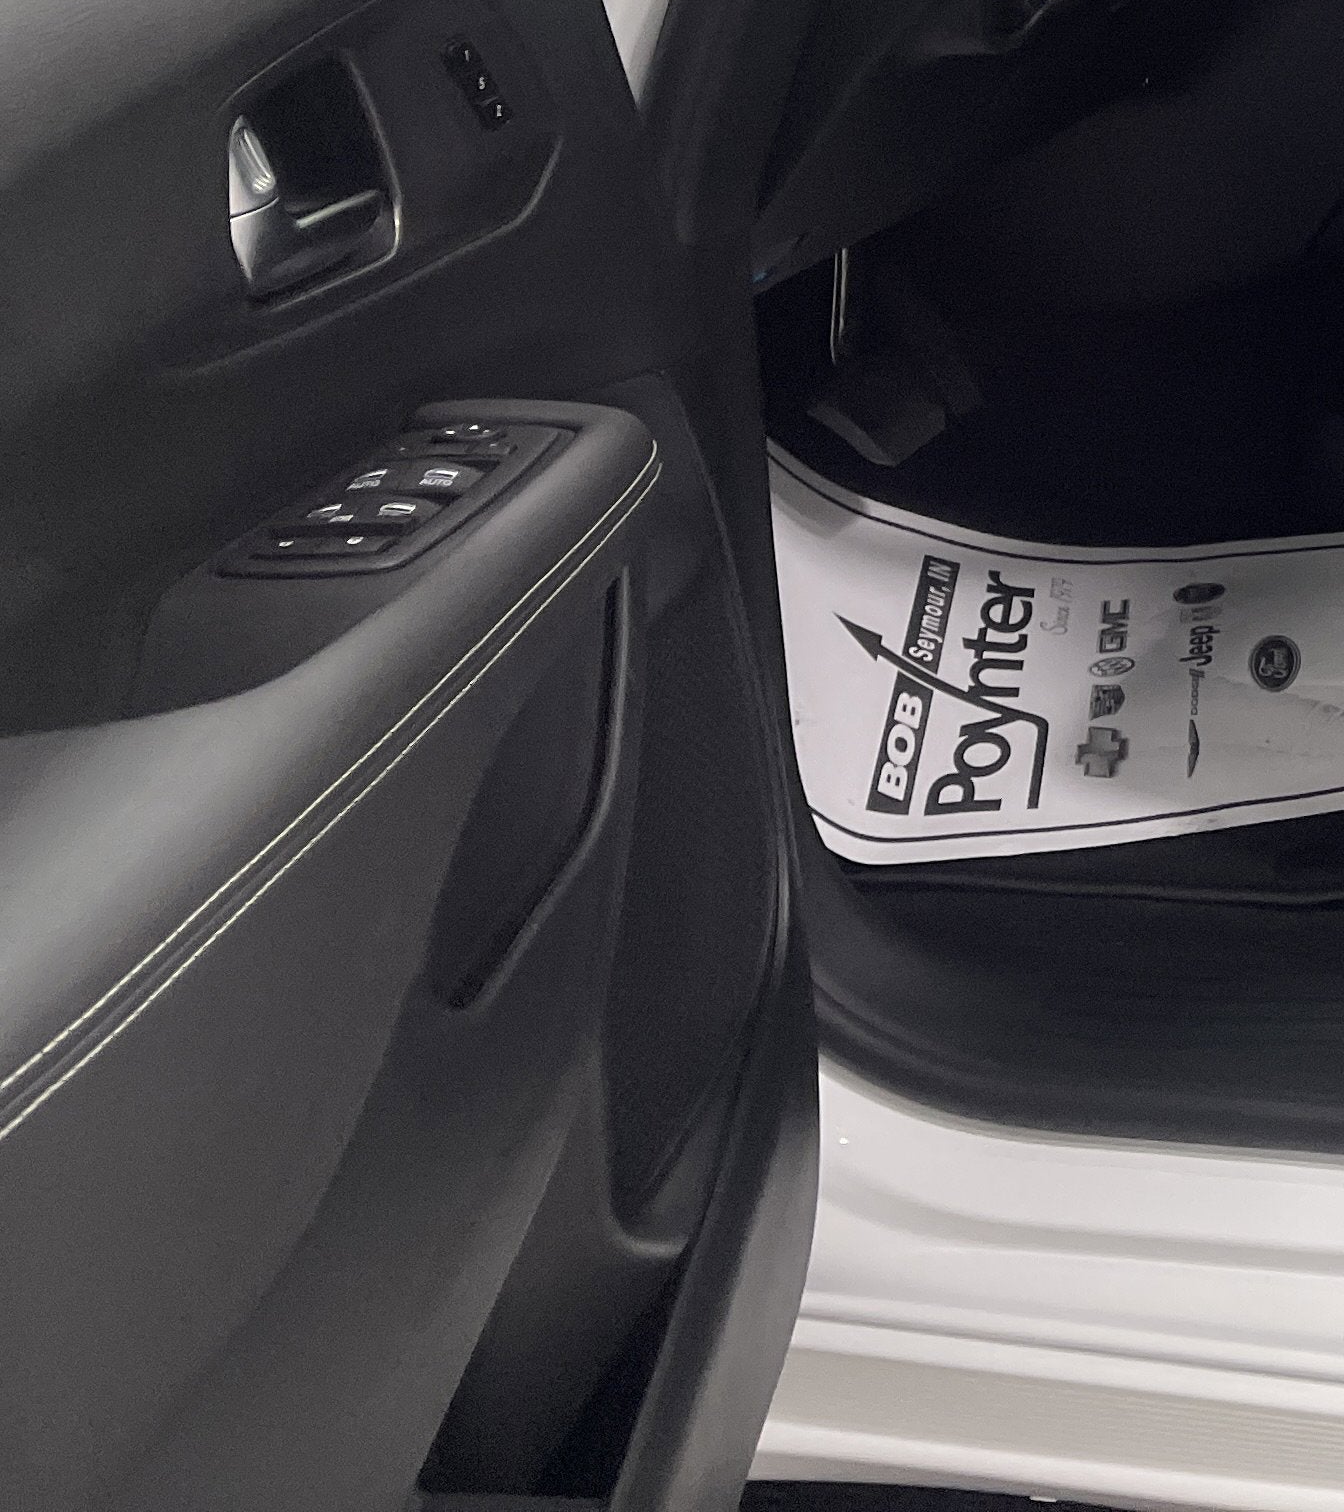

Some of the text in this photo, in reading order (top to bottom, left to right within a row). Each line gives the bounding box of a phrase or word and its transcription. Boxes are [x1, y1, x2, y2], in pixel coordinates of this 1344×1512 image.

[419, 476, 453, 488] AUTO
[1095, 598, 1131, 654] GMC
[1178, 624, 1221, 667] Jeep
[876, 558, 953, 802] BOB Seymour, IN
[922, 569, 1049, 817] Poynter
